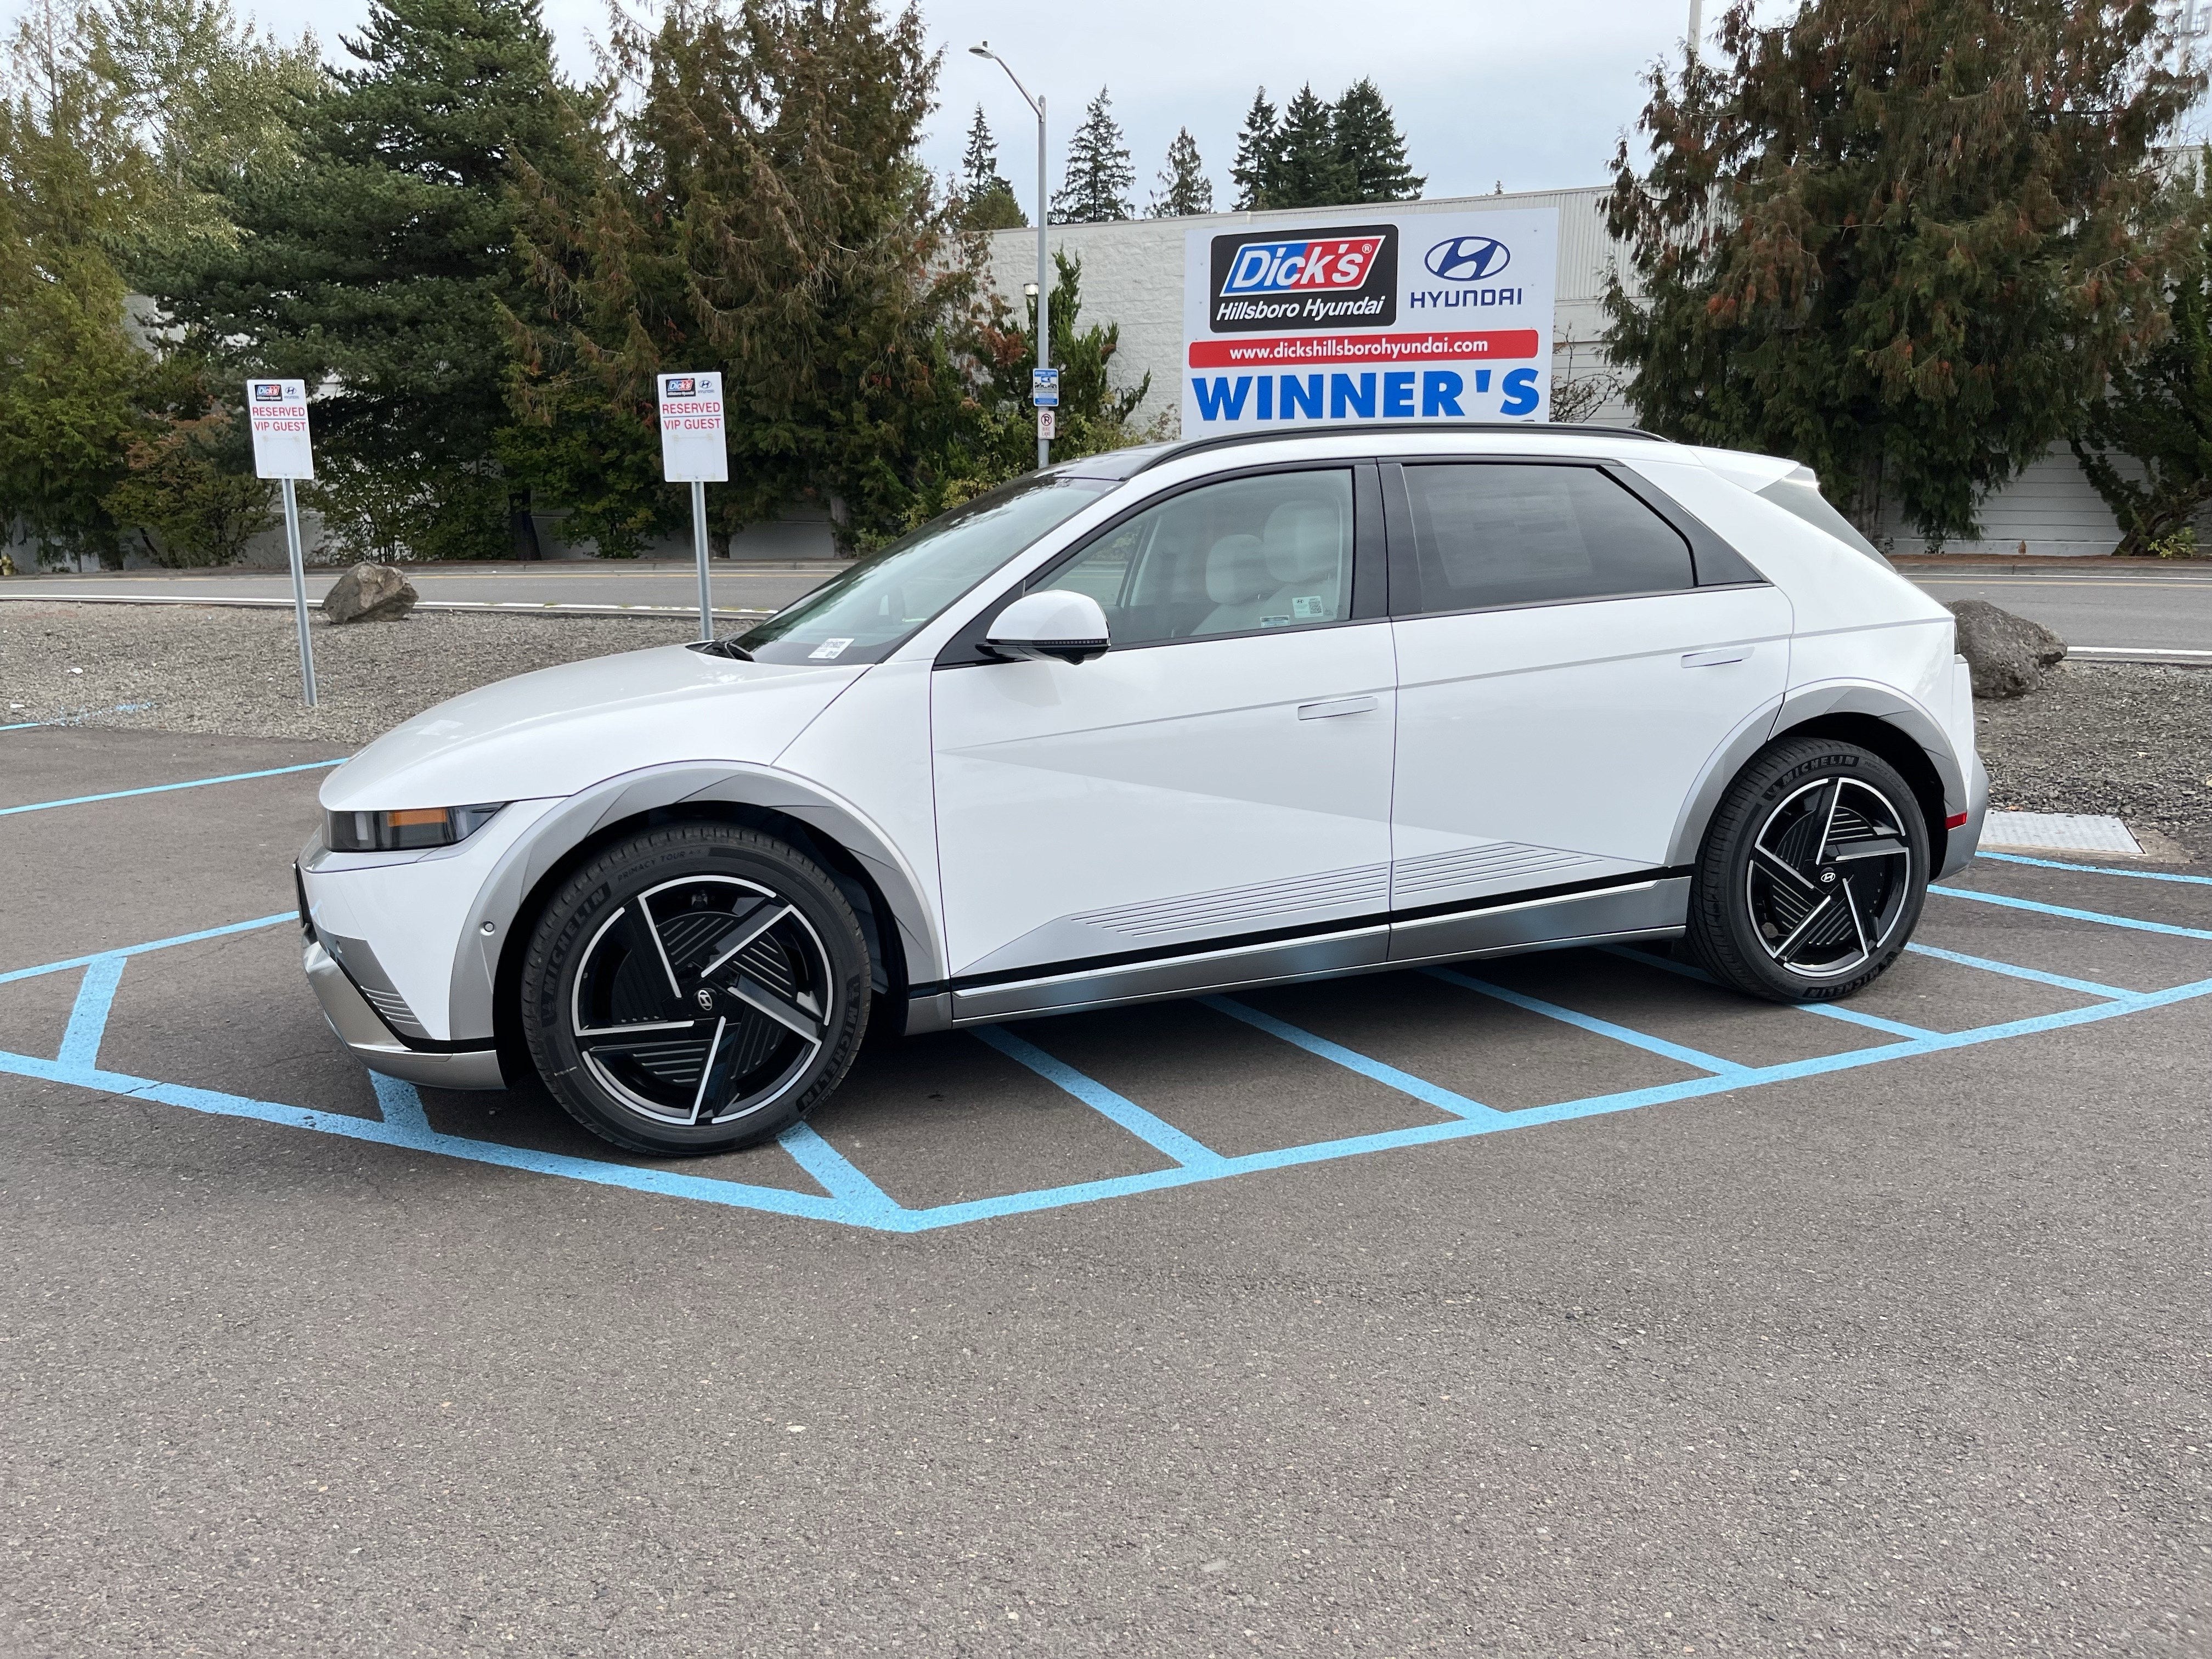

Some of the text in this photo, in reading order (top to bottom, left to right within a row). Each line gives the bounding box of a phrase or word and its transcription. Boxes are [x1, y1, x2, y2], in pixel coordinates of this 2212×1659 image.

[1232, 244, 1363, 288] Dick's
[1216, 295, 1386, 321] Hillsboro Hyundai
[1410, 288, 1522, 308] HYUNDAI
[1229, 336, 1488, 359] www.dickshillsborohyundai.com
[1191, 368, 1539, 421] WINNER'S
[252, 407, 305, 416] RESERVED
[662, 402, 720, 414] RESERVED
[254, 422, 306, 431] VIP GUEST
[663, 418, 721, 430] VIP GUEST
[1781, 755, 1856, 785] MICHELIN
[660, 851, 687, 862] TOUR
[543, 887, 606, 996] MICHELIN
[801, 1006, 859, 1108] MICHELIN
